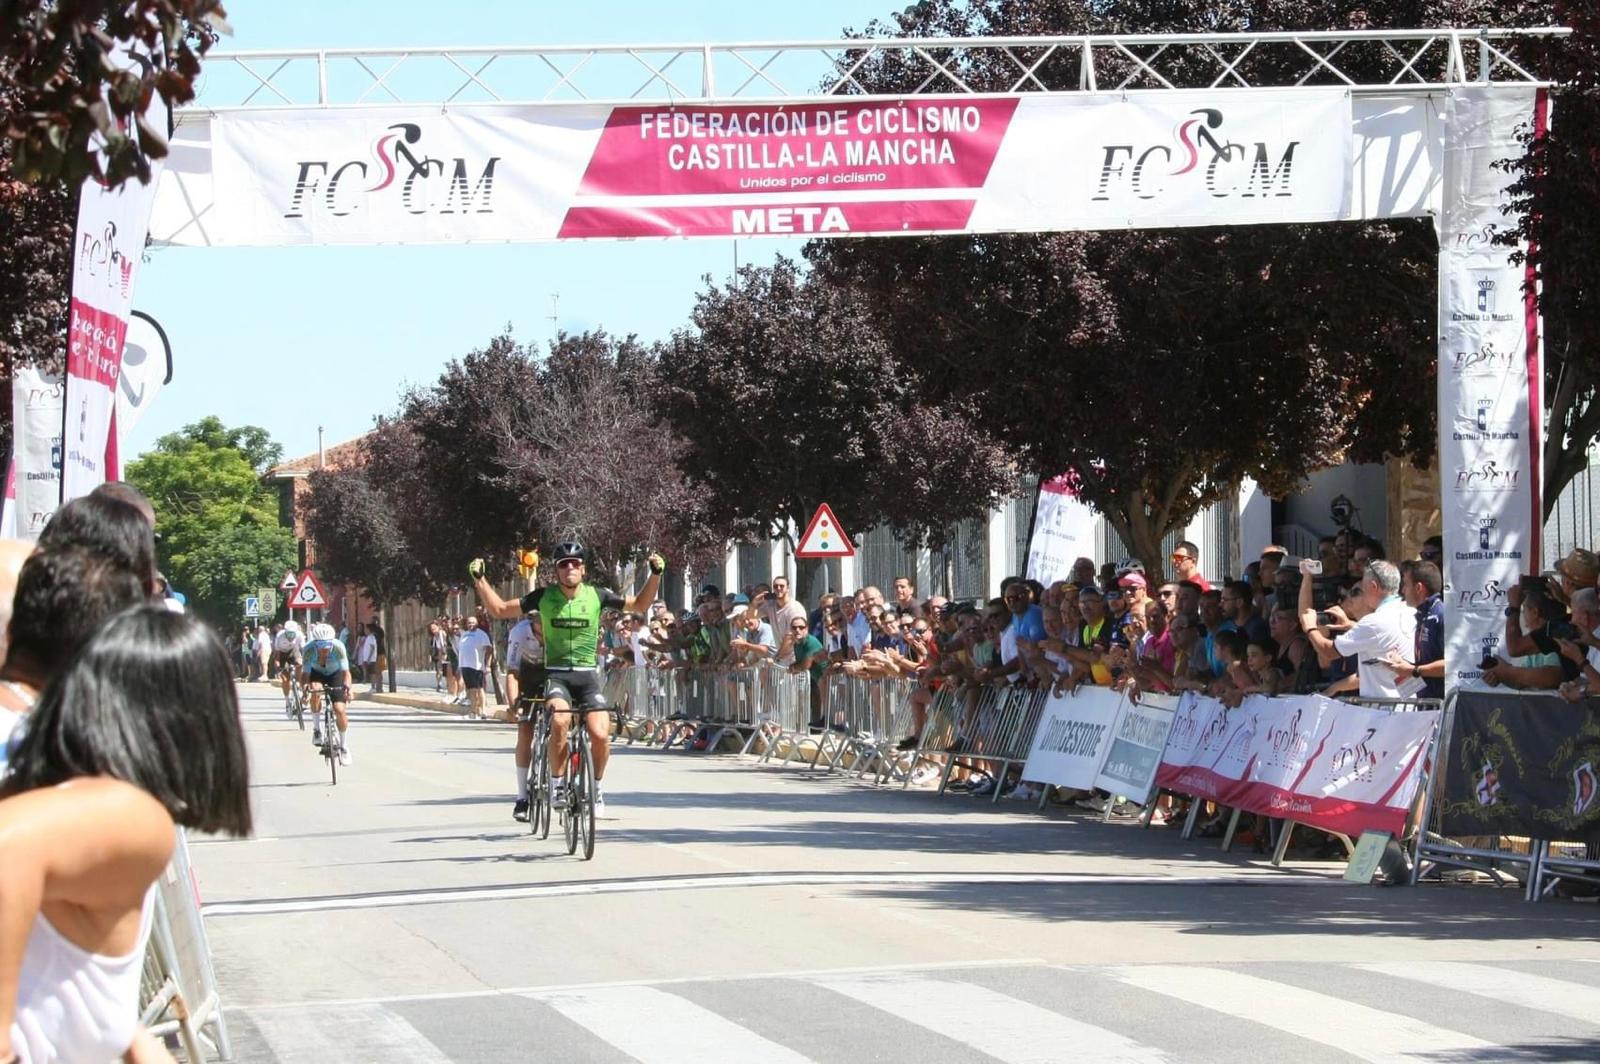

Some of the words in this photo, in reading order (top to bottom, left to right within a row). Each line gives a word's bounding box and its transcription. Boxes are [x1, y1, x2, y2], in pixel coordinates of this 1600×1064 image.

[639, 105, 807, 139] FEDERACIÓN
[815, 109, 848, 136] DE
[856, 105, 981, 135] CICLISMO
[668, 139, 838, 171] CASTILLA-LA
[845, 137, 956, 167] MANCHA
[739, 177, 786, 189] Unidos
[791, 175, 813, 189] por
[816, 173, 828, 185] el
[831, 171, 887, 184] ciclismo
[731, 206, 850, 234] META
